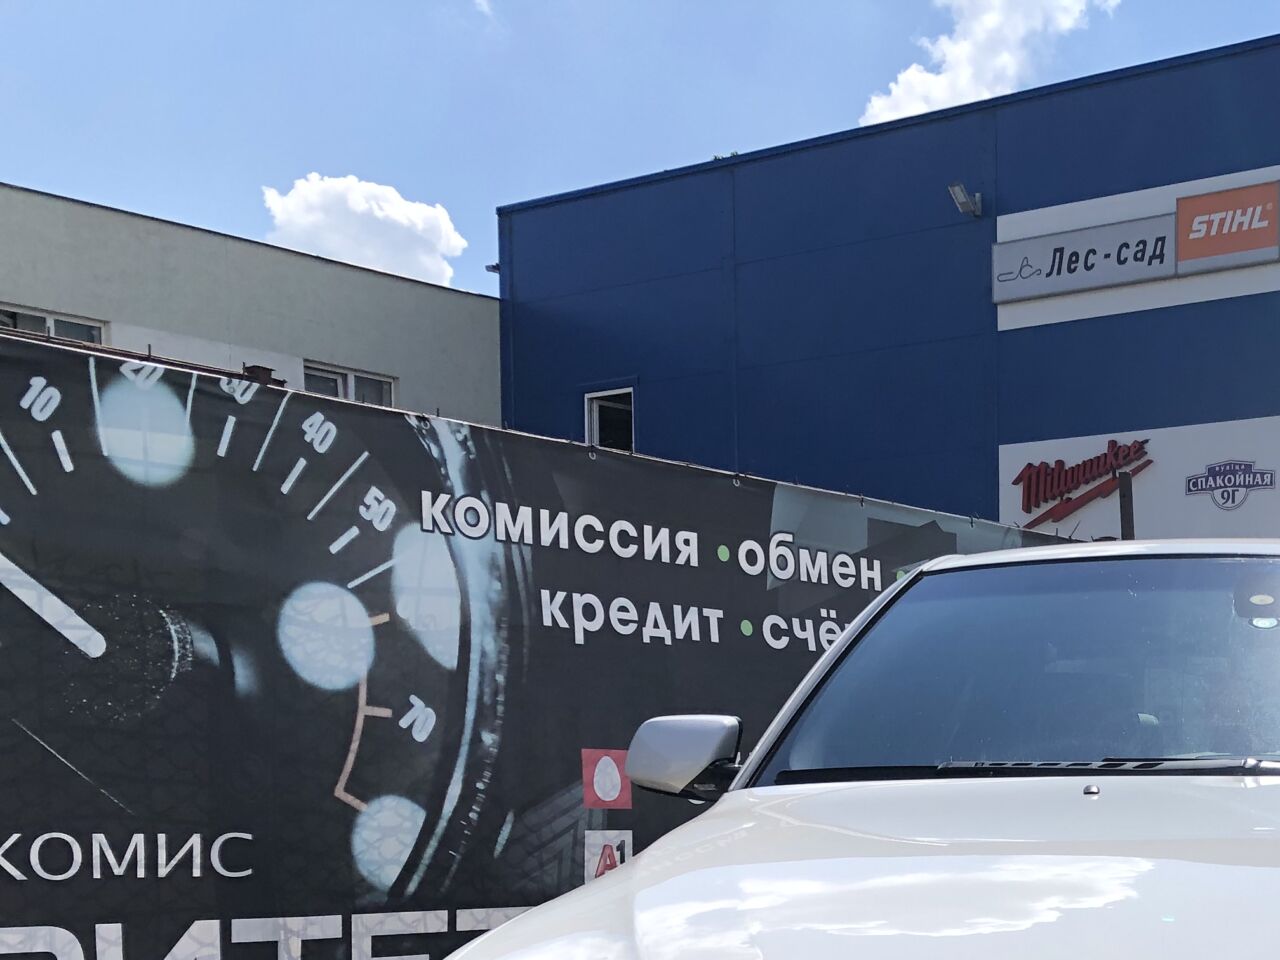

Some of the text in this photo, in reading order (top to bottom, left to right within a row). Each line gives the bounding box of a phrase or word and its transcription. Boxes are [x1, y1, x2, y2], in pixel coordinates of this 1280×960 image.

[1188, 205, 1269, 239] STIHL
[1046, 235, 1167, 278] Лес-сад
[20, 376, 61, 421] 10
[301, 411, 338, 454] 40
[1012, 439, 1150, 514] Milwaukee
[1189, 471, 1271, 490] СПАКОЙНАЯ
[1220, 489, 1239, 505] 9Г
[359, 486, 397, 532] 50
[420, 490, 882, 592] комиссия обмен
[540, 589, 851, 652] кредит счё
[399, 694, 436, 742] 70
